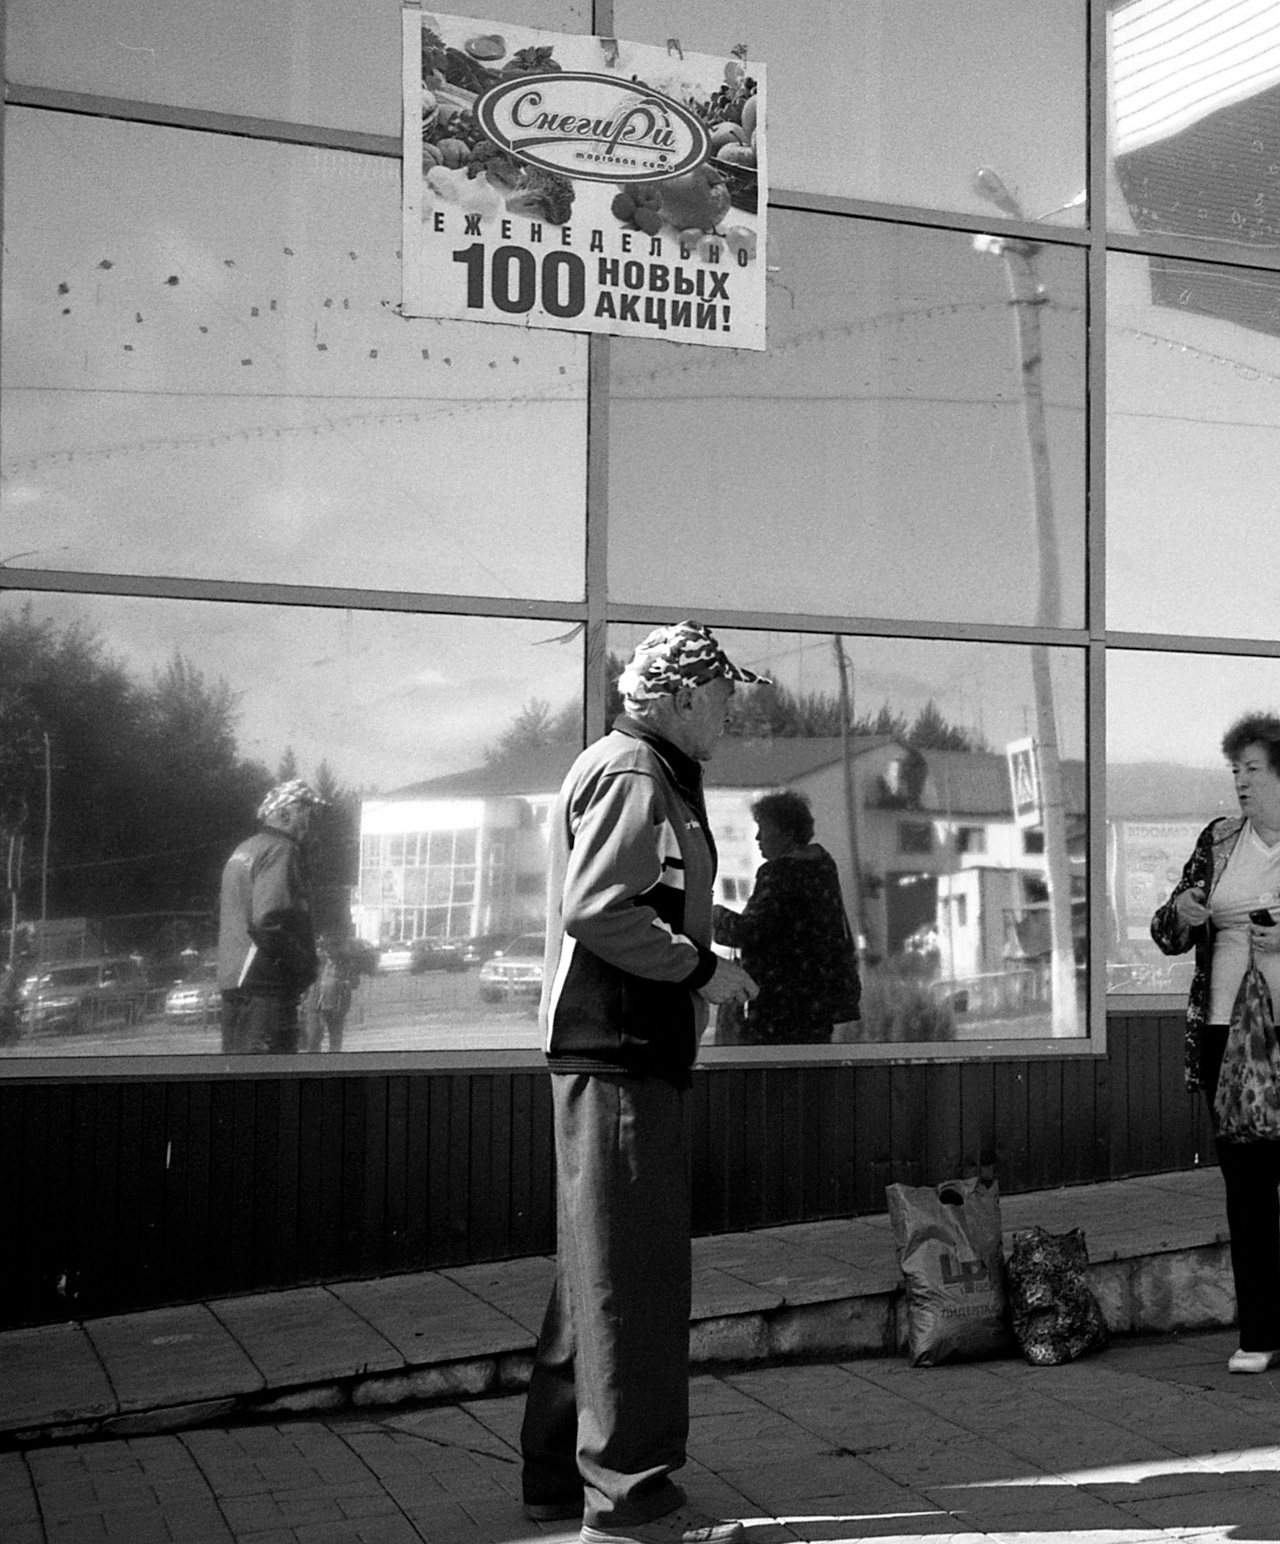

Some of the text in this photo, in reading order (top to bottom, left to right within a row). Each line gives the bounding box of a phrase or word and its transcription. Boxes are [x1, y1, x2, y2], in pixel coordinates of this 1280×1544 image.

[576, 152, 673, 172] торговая сеть
[434, 212, 748, 267] ЕЖЕНЕДЕЛЬНО
[453, 243, 730, 318] 100 НОВЫХ
[595, 290, 731, 331] АКЦИЙ!
